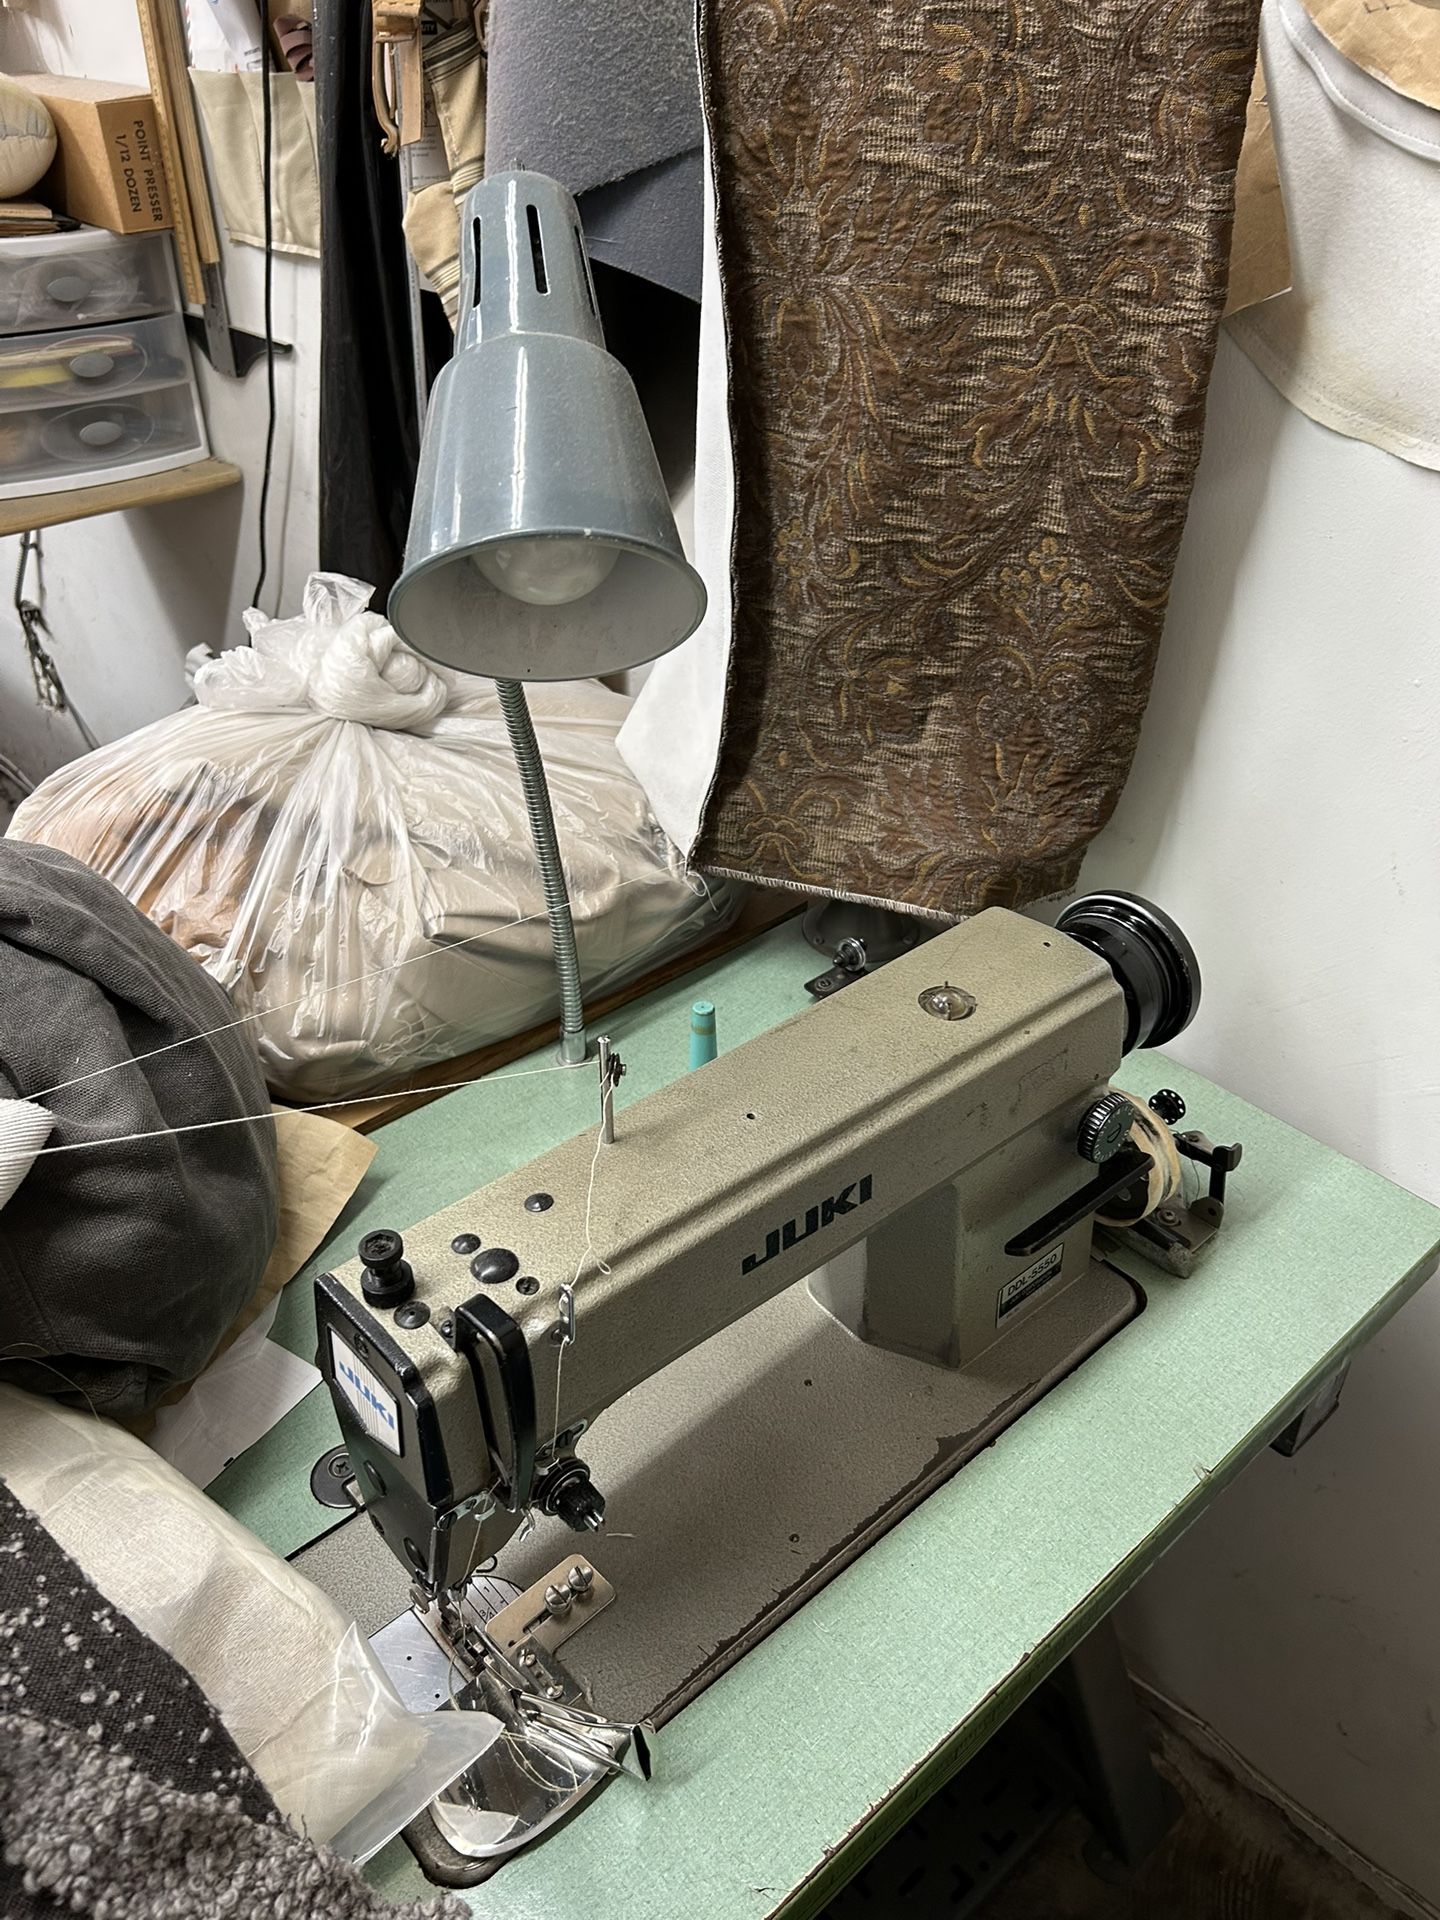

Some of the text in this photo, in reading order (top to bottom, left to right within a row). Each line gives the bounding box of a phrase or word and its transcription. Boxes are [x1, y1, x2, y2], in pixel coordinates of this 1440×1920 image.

[115, 134, 142, 213] 1/12 DOZEN
[133, 120, 163, 222] POINT PRESSER
[742, 1173, 872, 1275] JUKI
[1008, 1253, 1057, 1296] DDL-5550
[339, 1360, 395, 1430] JUKI
